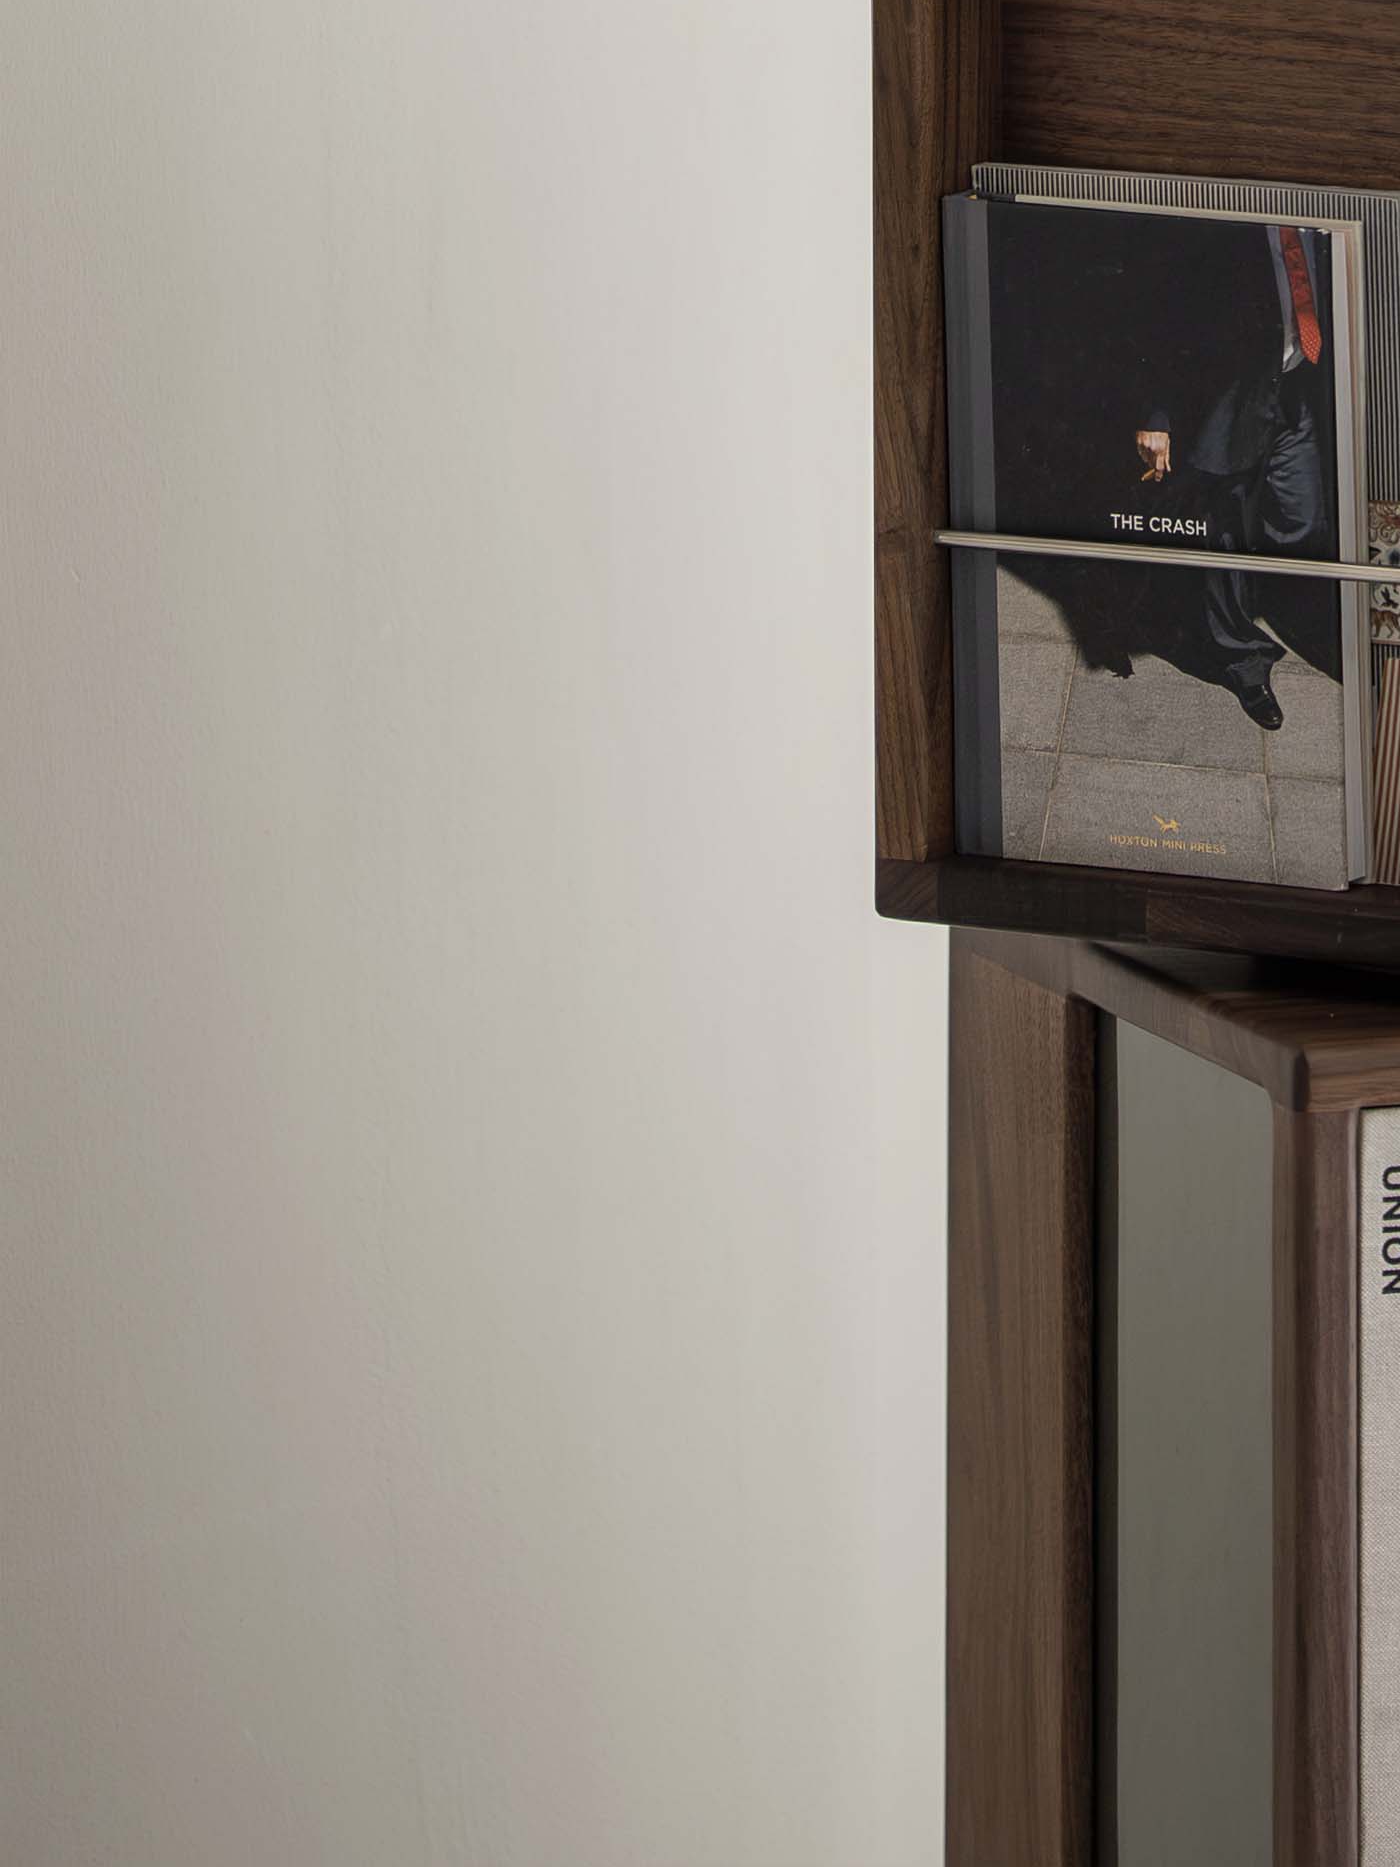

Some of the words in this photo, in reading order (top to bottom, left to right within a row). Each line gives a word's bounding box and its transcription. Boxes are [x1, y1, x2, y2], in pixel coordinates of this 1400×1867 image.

[1110, 513, 1144, 531] THE
[1149, 516, 1207, 537] CRASH
[1161, 838, 1187, 851] MINI
[1190, 841, 1227, 854] PRESS
